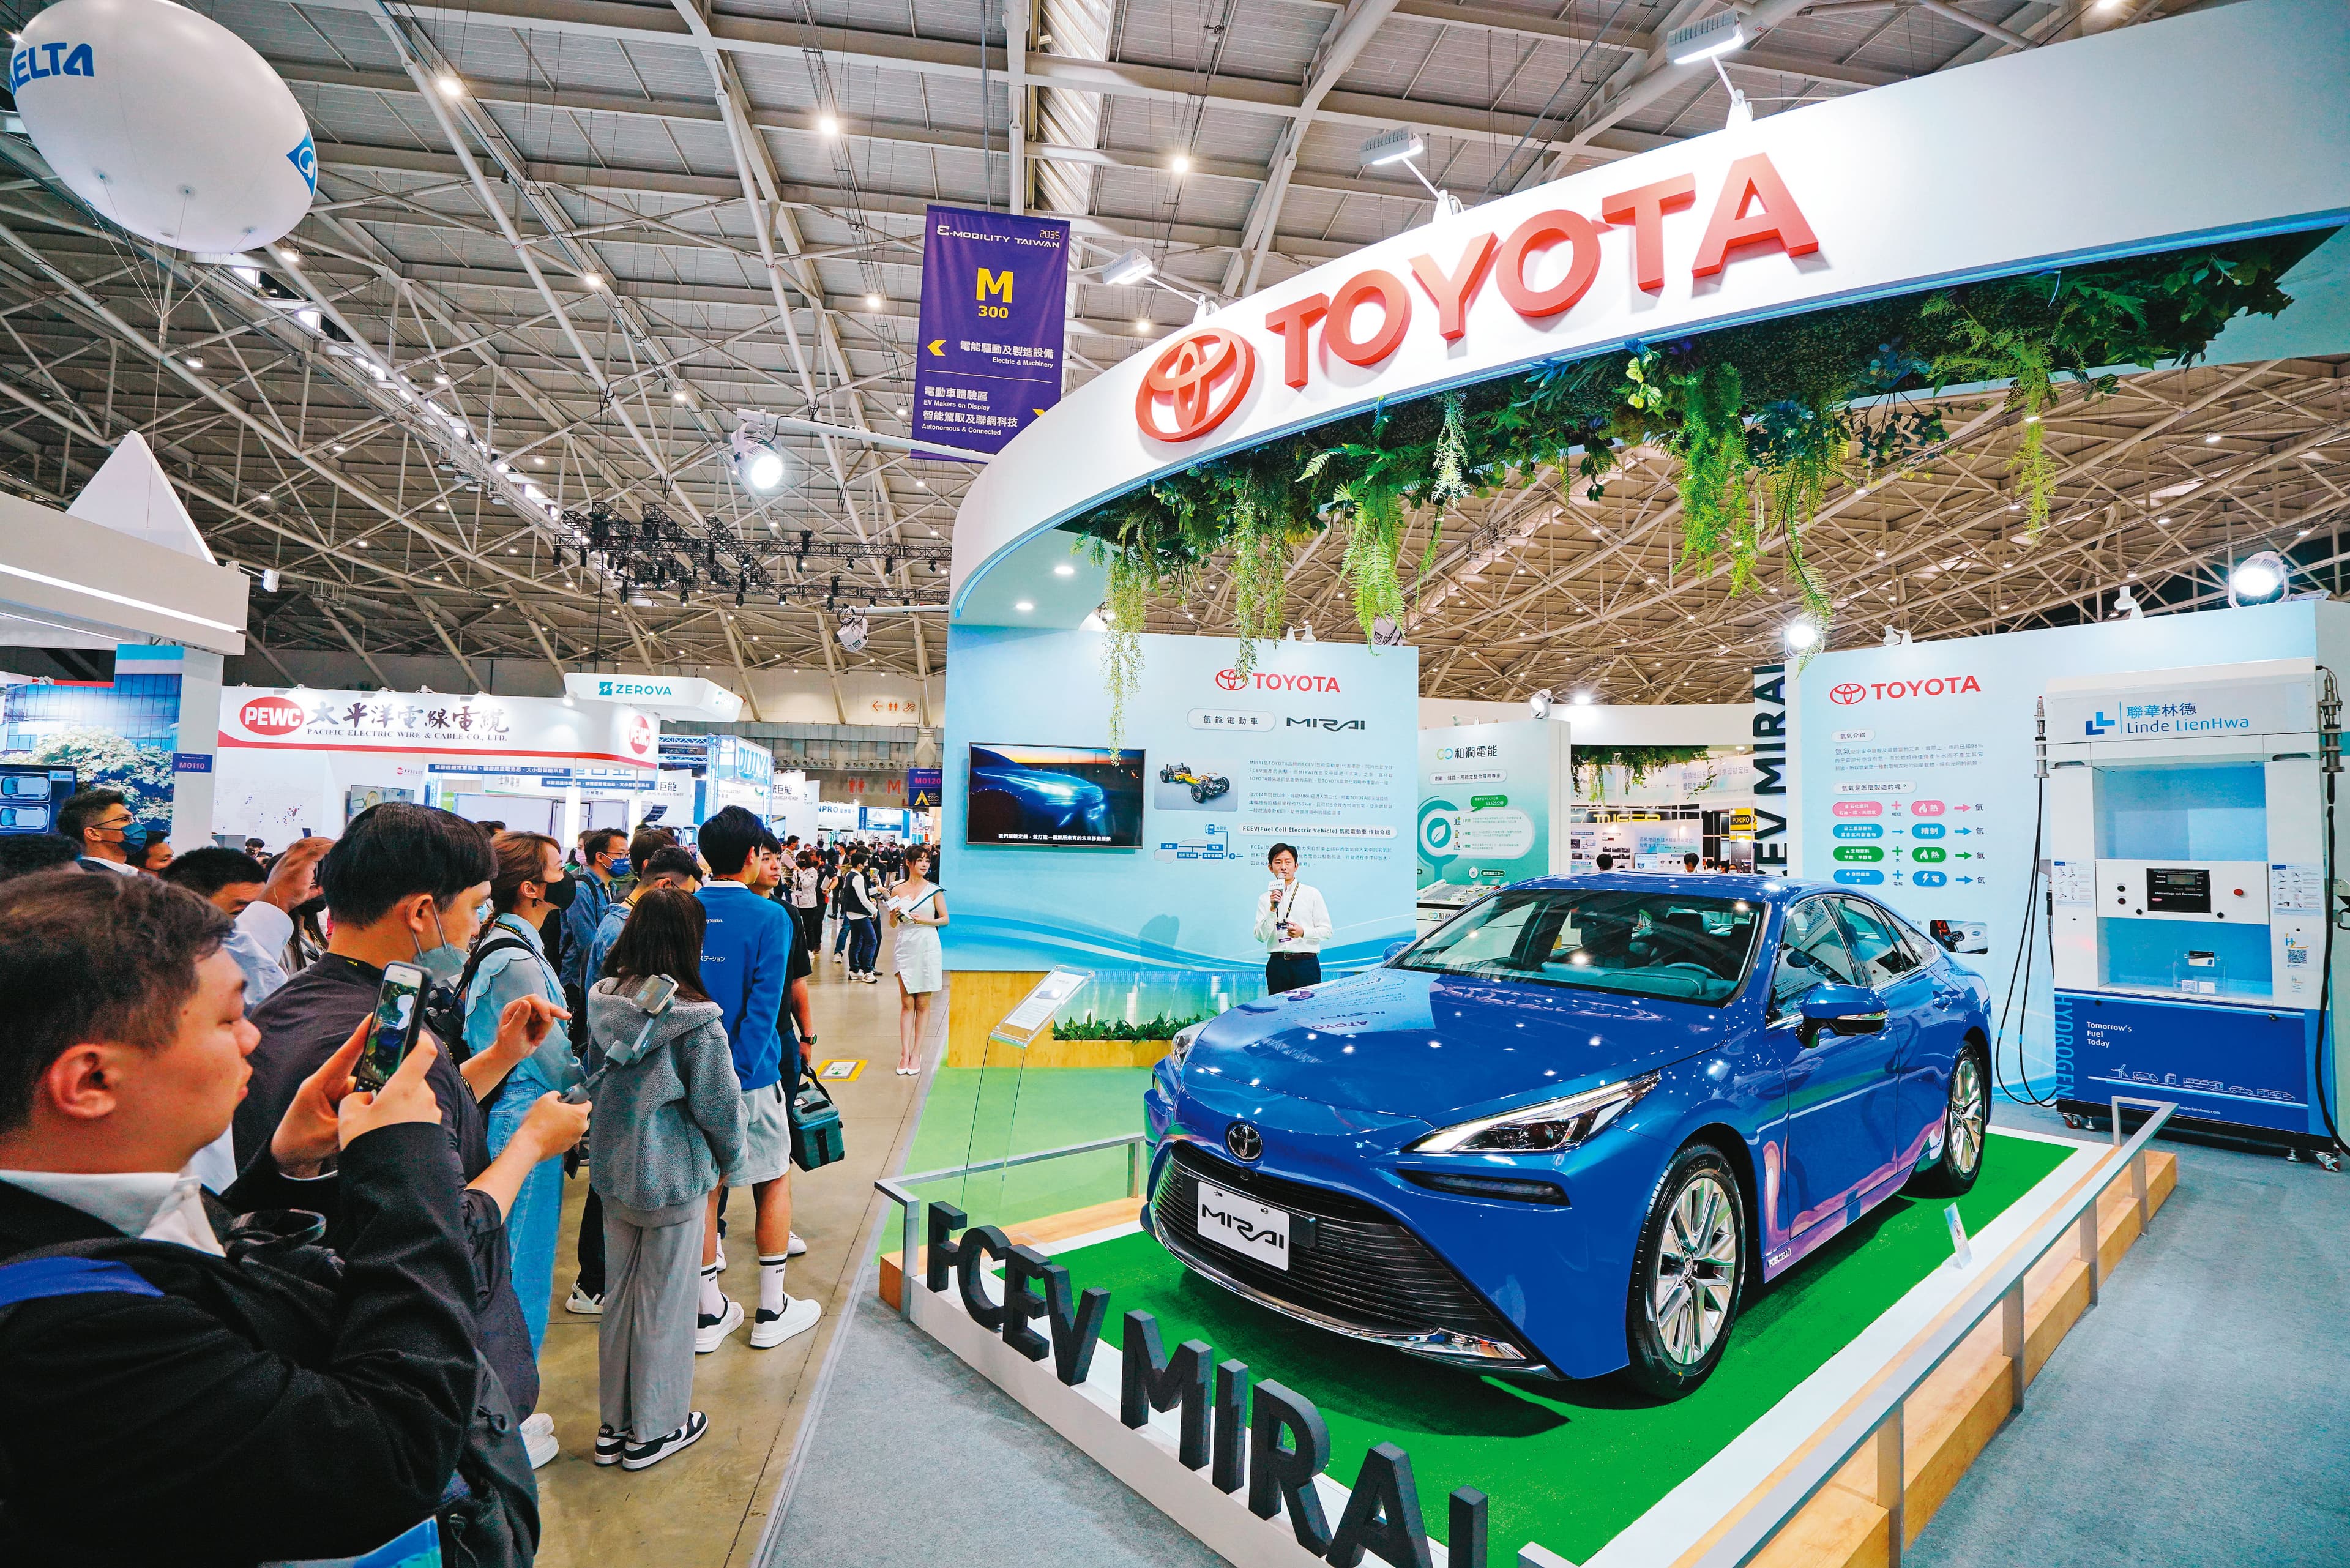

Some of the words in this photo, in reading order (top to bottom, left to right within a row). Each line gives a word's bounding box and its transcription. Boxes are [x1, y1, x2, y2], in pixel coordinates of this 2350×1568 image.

[1014, 237, 1060, 248] TAIWAN
[1039, 230, 1060, 240] 2035
[1266, 152, 1818, 388] TOYOTA
[976, 267, 1013, 303] M
[978, 305, 1009, 319] 300
[960, 340, 1054, 359] 電能驅動及製造設備
[1023, 360, 1053, 368] Machinery
[924, 386, 988, 401] 電動車體驗區
[968, 403, 990, 412] Display
[923, 410, 1018, 427] 智能駕馭及聯網科技
[922, 424, 960, 432] Autonomous
[968, 427, 1001, 436] Connected
[616, 684, 672, 696] ZEROVA
[1252, 673, 1341, 693] TOYOTA
[1871, 675, 1981, 700] TOYOTA
[245, 707, 302, 727] PEWC
[306, 701, 509, 733] 太平洋電線電纜
[2127, 702, 2196, 719] 聯華林德
[1203, 715, 1258, 725] 氫能電動車
[1286, 717, 1365, 732] MIRAI
[1752, 664, 1786, 794] MIRAI
[2127, 720, 2169, 734] Linde
[2176, 717, 2249, 731] LienHwa
[629, 725, 650, 746] PEWC
[1455, 745, 1497, 759] 和潤電能
[887, 779, 901, 794] M
[1753, 808, 1787, 877] EV
[2055, 994, 2075, 1097] HYDROGEN
[2087, 1039, 2110, 1048] Today
[1201, 1203, 1285, 1250] MIRAI
[927, 1201, 1111, 1386] FCEV
[1121, 1310, 1488, 1568] MIRAI
